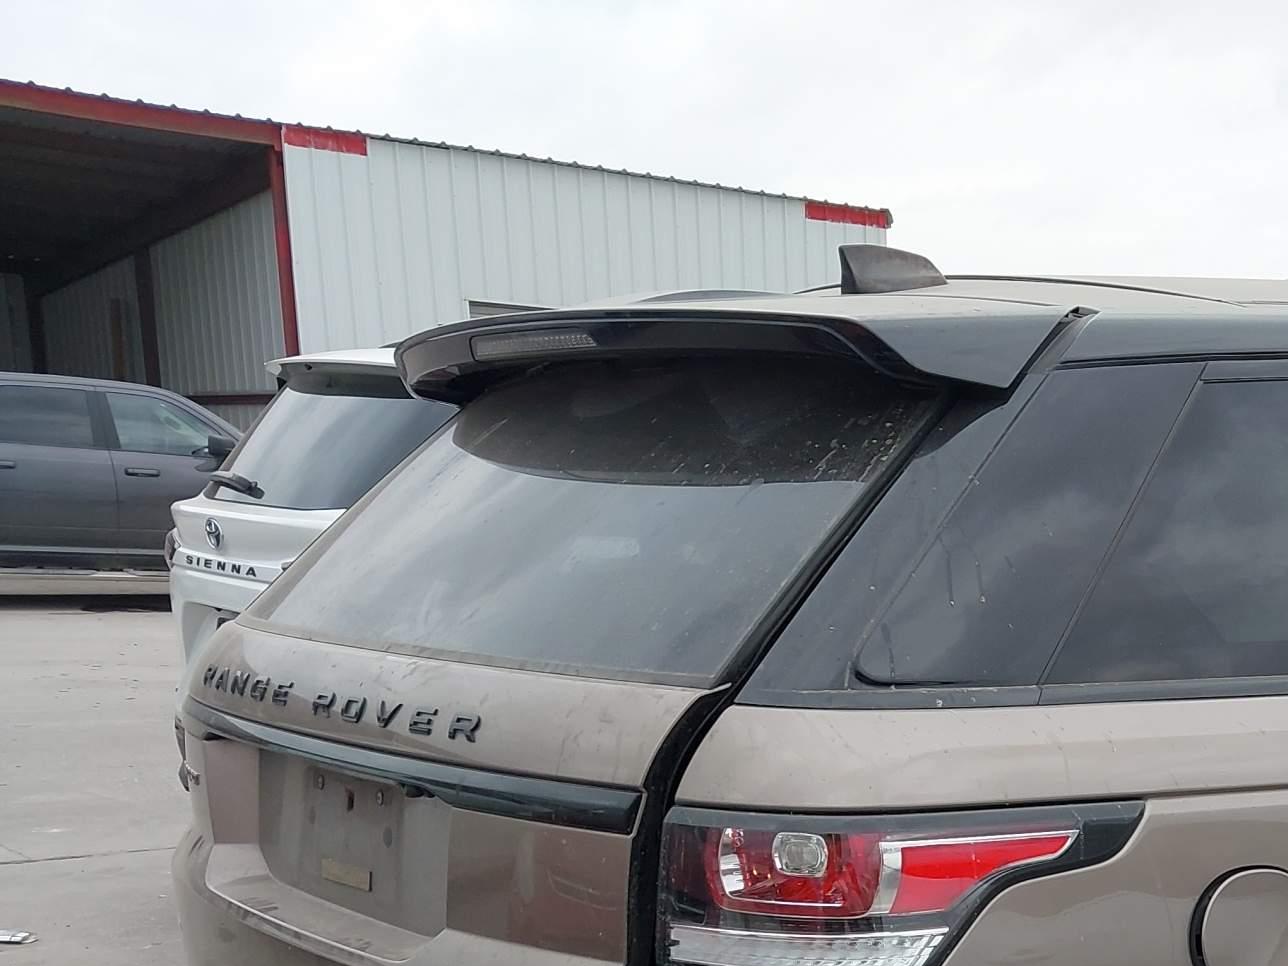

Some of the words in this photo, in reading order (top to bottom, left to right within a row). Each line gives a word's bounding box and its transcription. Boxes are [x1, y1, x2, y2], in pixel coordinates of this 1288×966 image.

[185, 555, 257, 577] SIENNA
[203, 664, 294, 707] RANGE
[312, 691, 482, 743] ROVER
